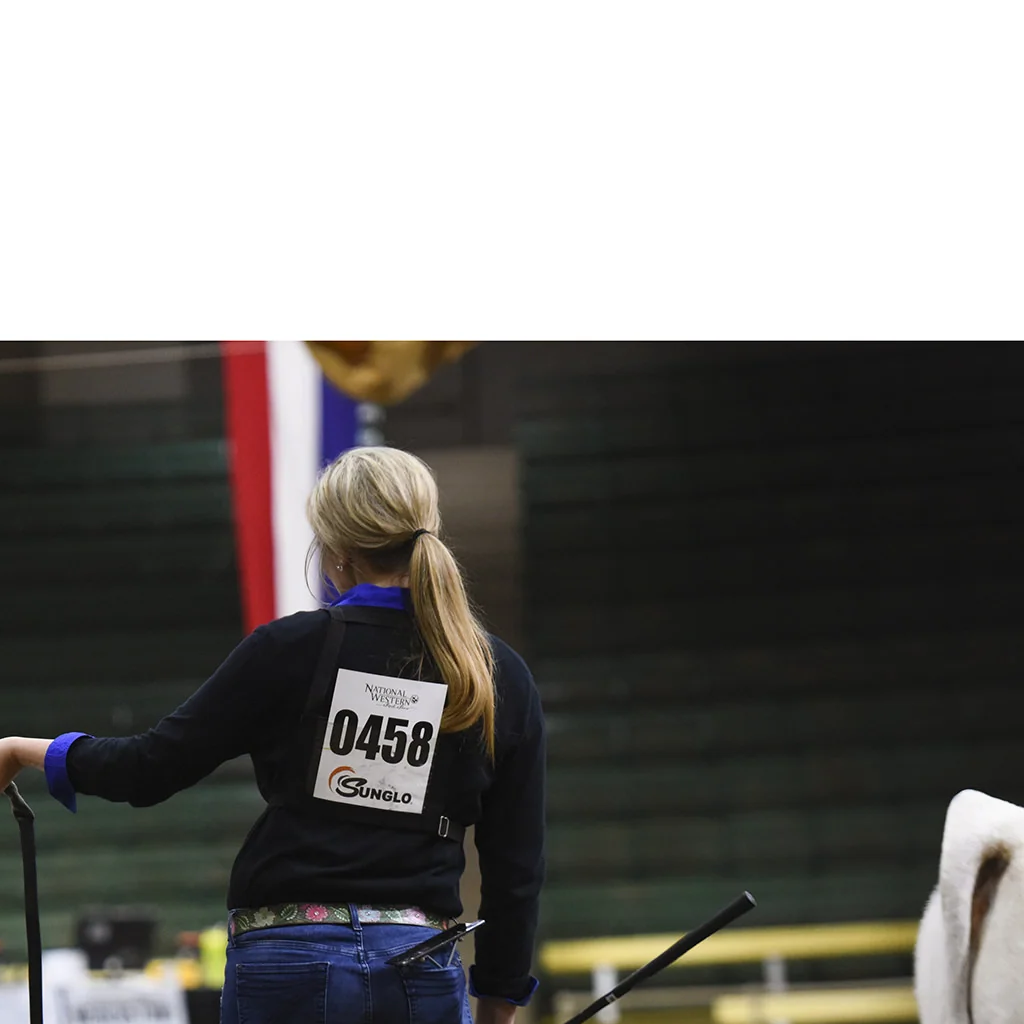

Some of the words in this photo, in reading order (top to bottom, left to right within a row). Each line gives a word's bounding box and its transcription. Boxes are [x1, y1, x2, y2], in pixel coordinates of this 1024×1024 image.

[365, 683, 406, 697] NATIONAL
[371, 693, 410, 706] WESTERN
[329, 709, 434, 767] 0458
[335, 775, 412, 804] SUNGLO
